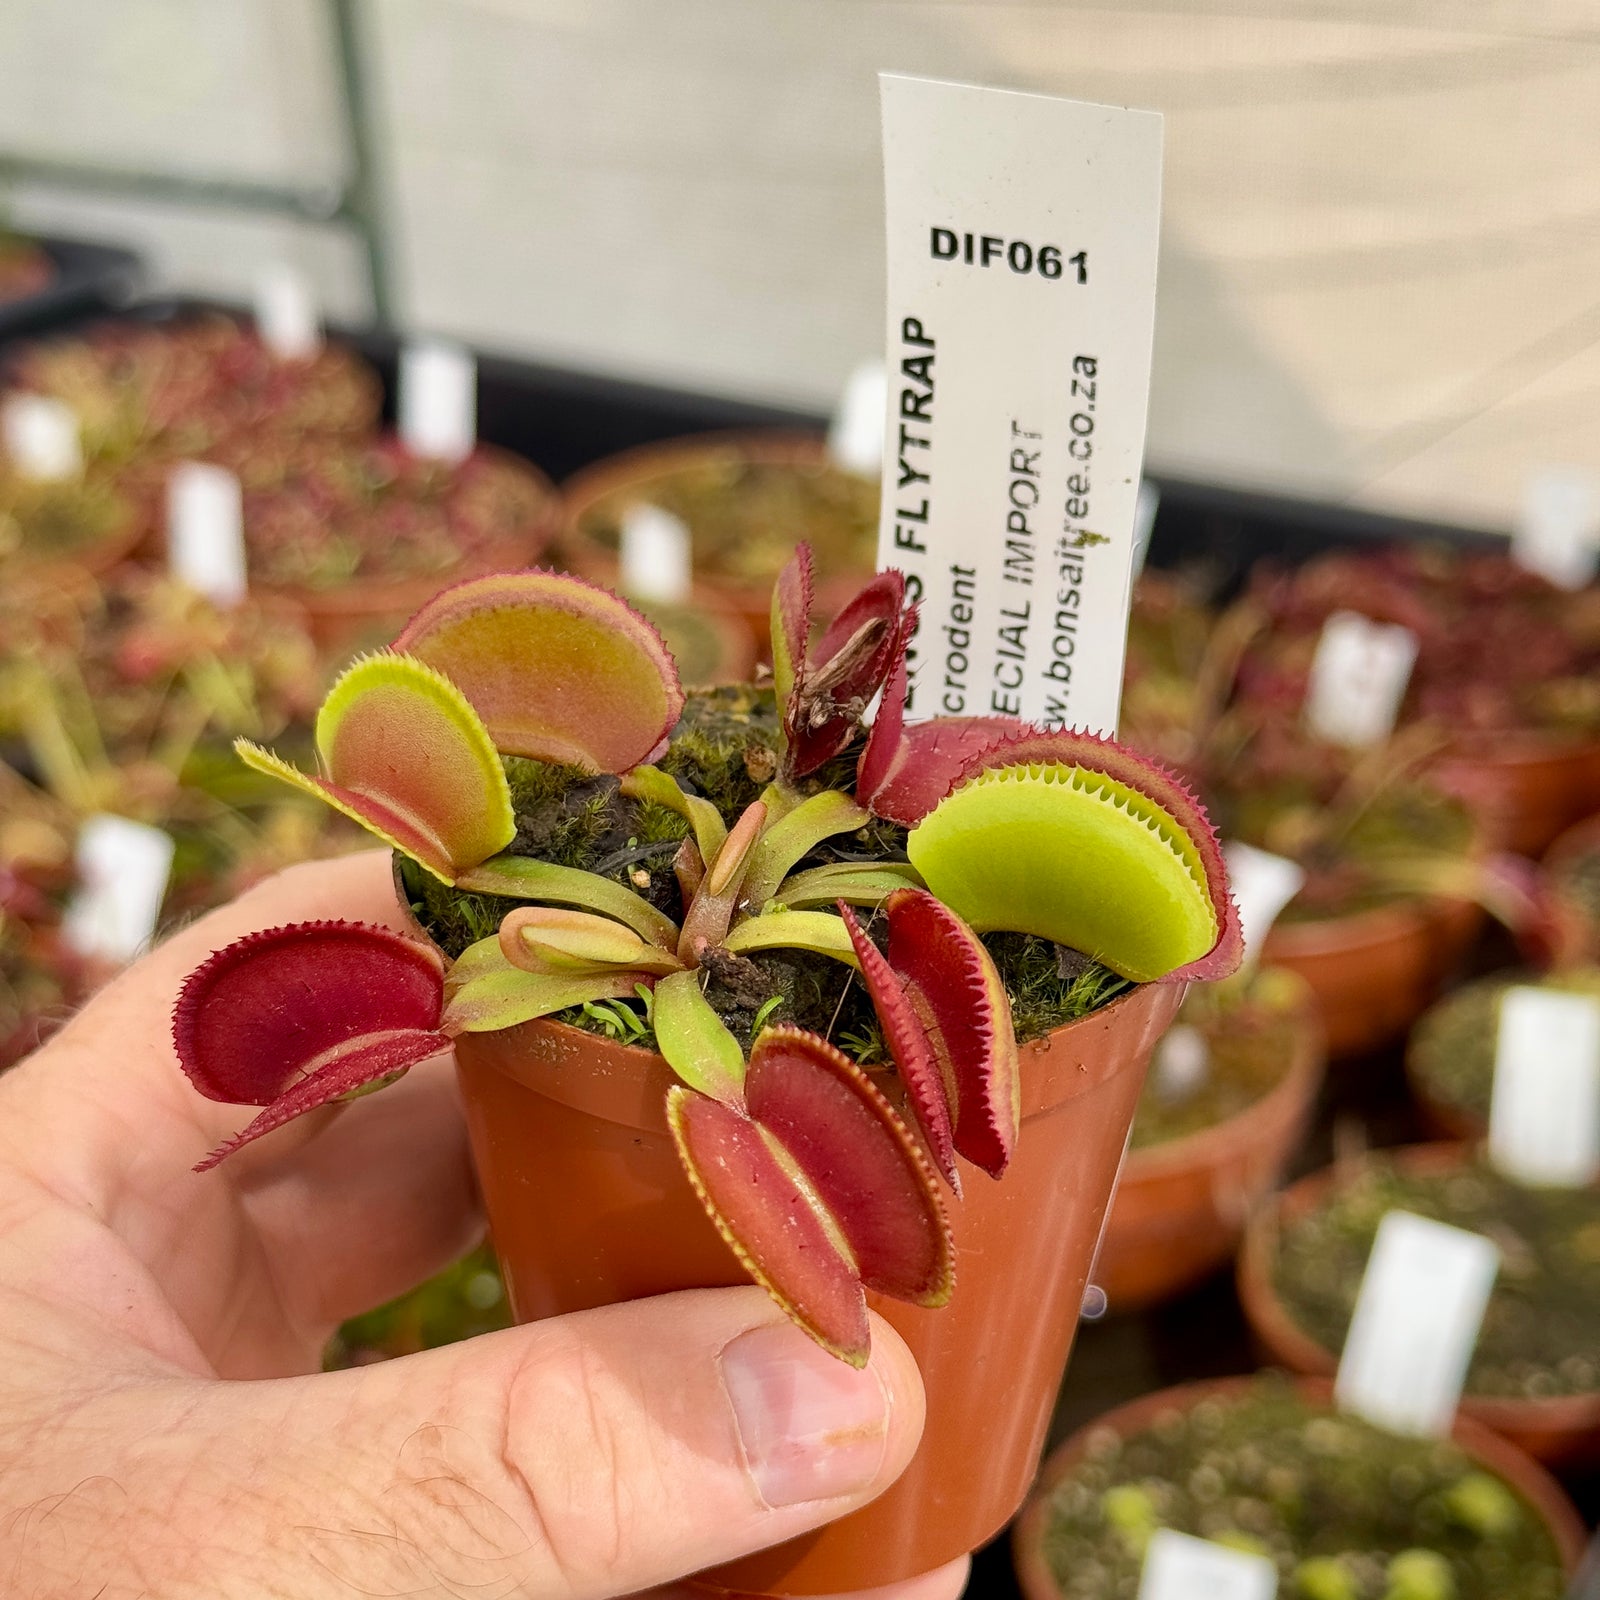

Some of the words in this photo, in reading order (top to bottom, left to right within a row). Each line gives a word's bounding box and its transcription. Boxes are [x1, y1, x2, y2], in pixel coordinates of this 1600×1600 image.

[929, 226, 1089, 286] DIF061
[893, 316, 937, 554] FLYTRAP
[1003, 419, 1043, 586] IMPORT
[1042, 354, 1099, 729] w.bonsaitree.co.za
[941, 564, 977, 718] crodent
[990, 599, 1032, 716] ECIAL
